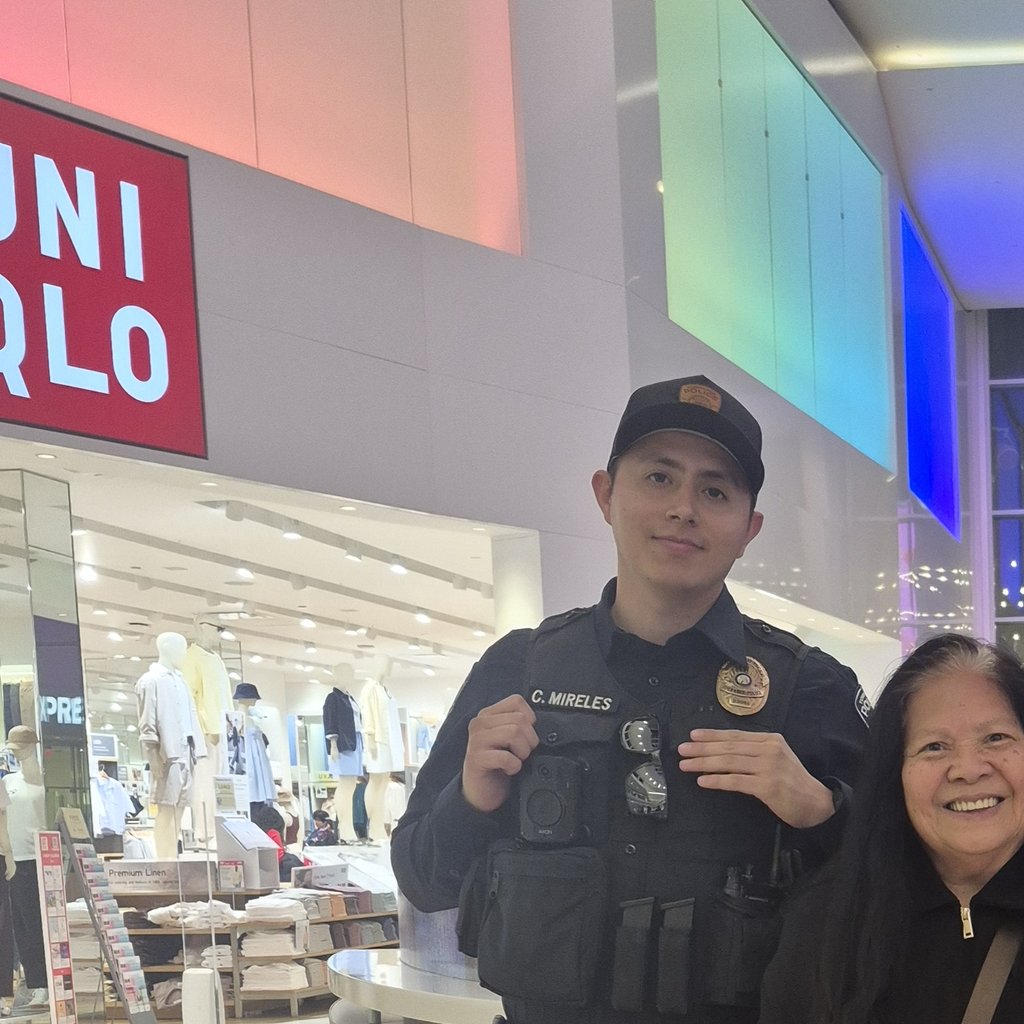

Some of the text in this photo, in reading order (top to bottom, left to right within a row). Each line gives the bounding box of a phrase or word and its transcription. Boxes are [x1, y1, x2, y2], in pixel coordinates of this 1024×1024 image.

[531, 689, 613, 711] C. MIRELES
[109, 869, 166, 877] Premium Linen
